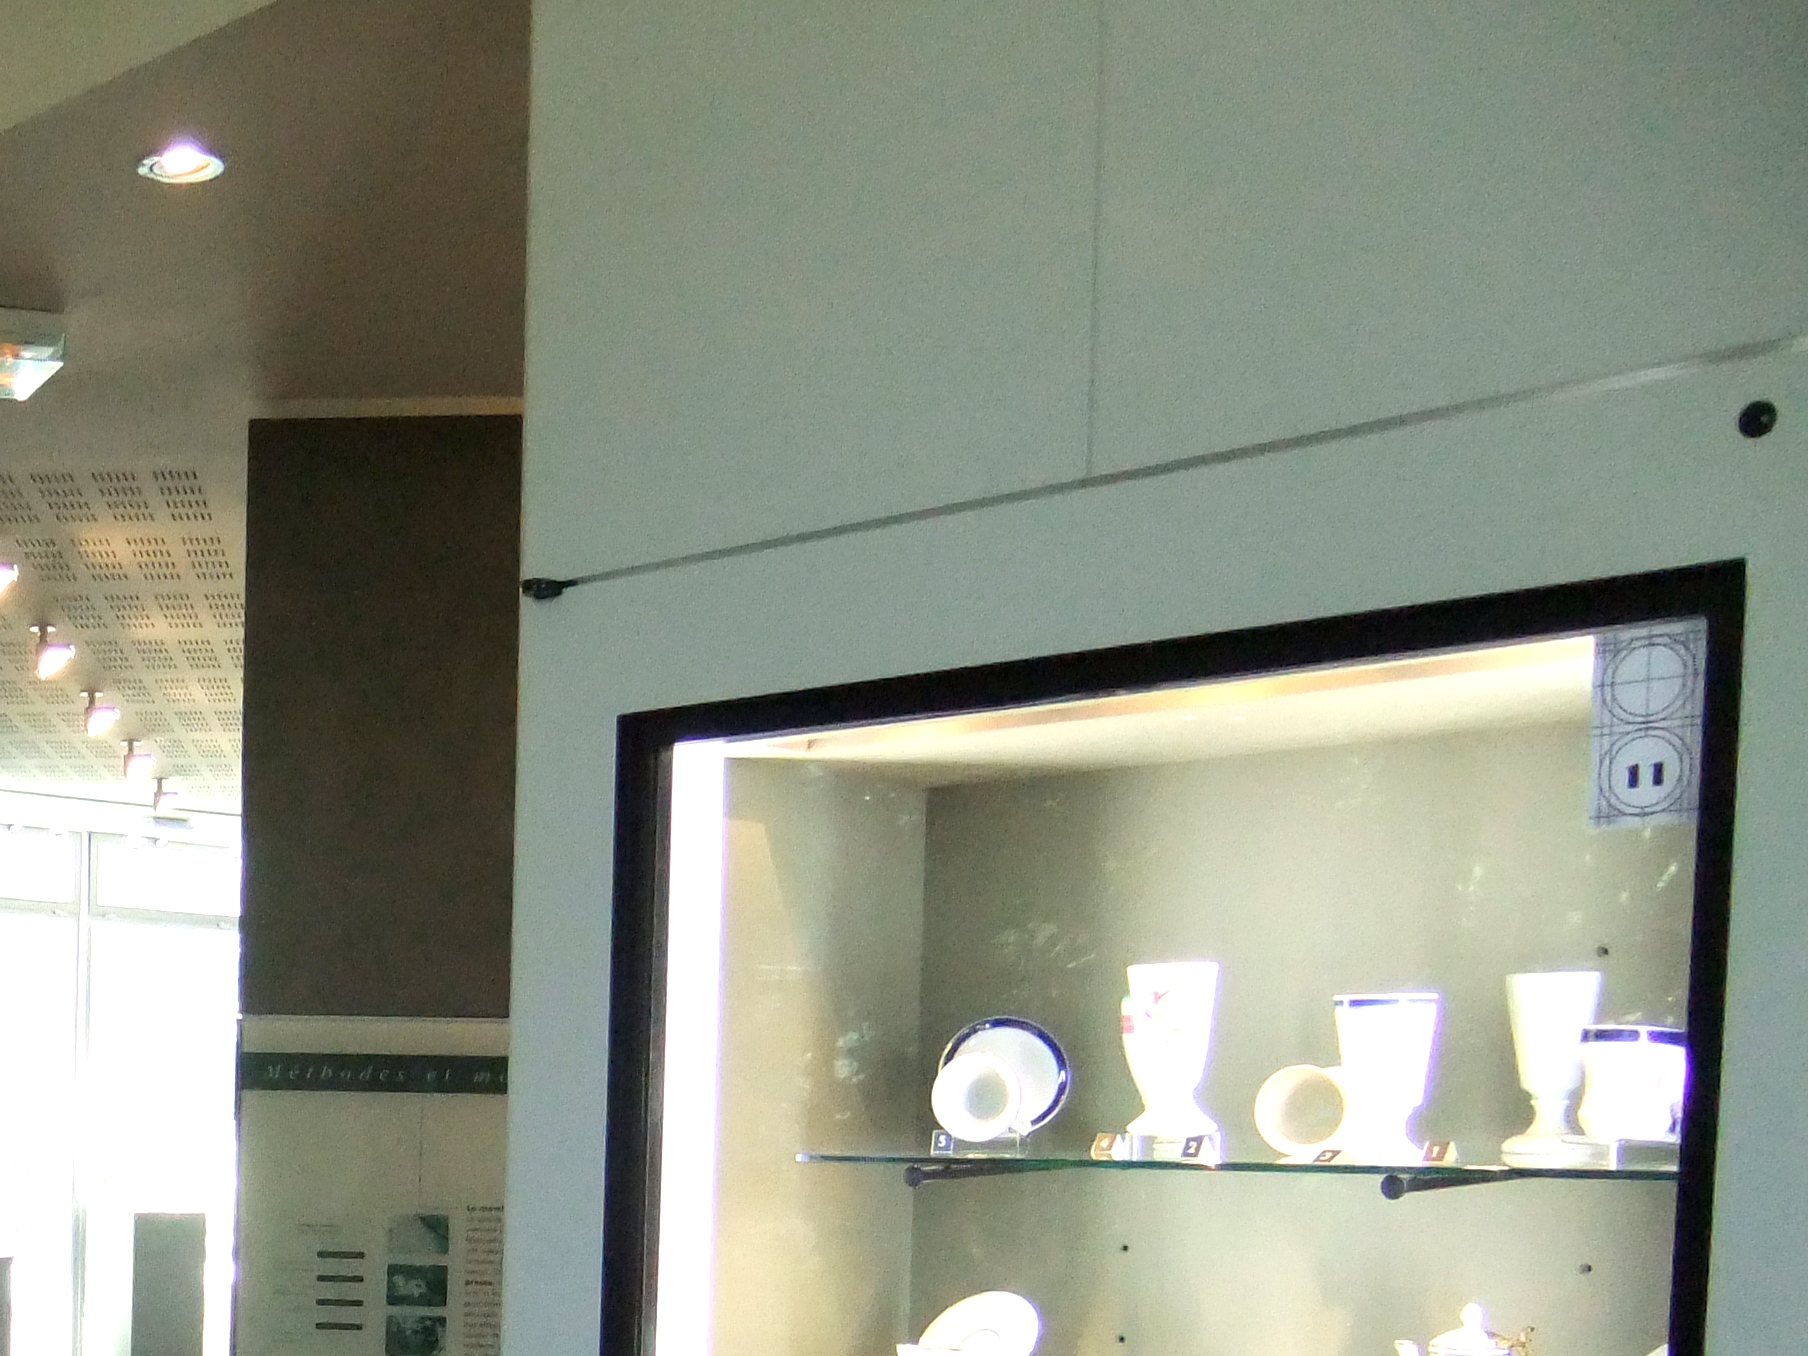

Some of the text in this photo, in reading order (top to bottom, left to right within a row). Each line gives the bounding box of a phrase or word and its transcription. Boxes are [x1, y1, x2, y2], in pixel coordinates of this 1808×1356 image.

[426, 1068, 452, 1083] et
[937, 1134, 948, 1148] 5
[1186, 1141, 1198, 1154] 2
